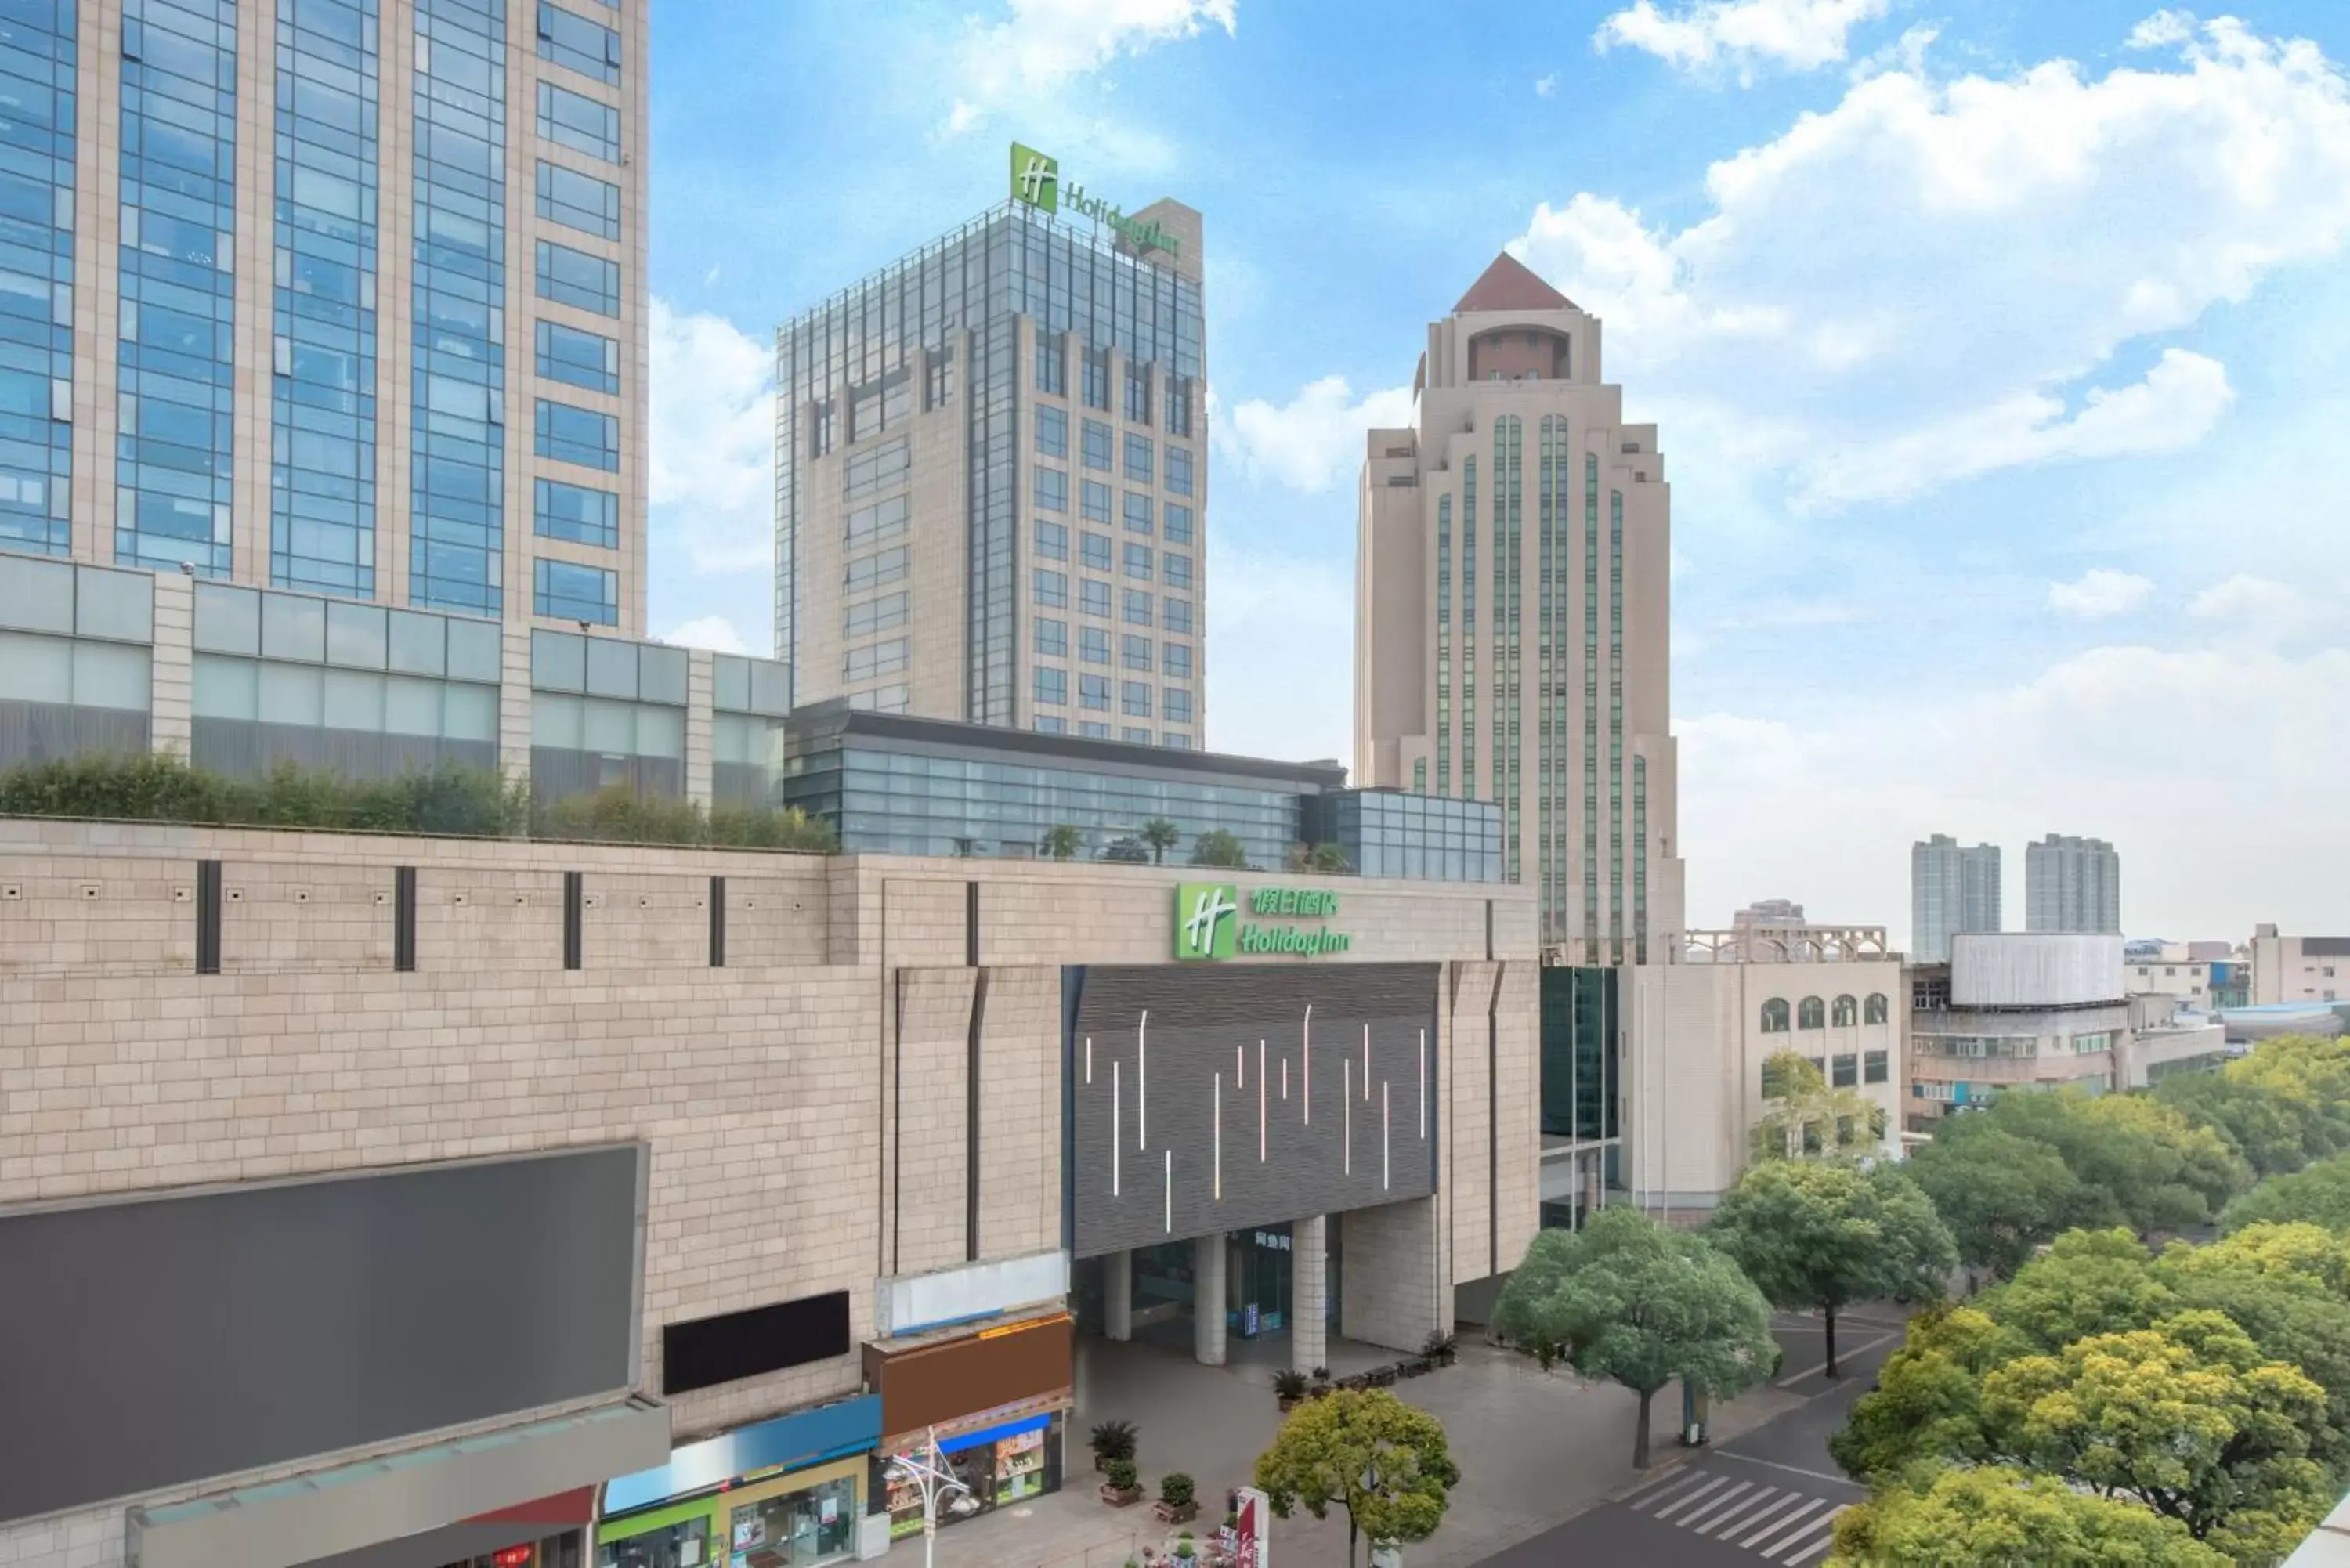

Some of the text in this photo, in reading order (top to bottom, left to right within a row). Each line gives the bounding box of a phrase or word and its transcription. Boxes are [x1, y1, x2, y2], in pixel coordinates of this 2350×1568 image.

[1251, 886, 1340, 916] 假日酒店
[1242, 923, 1321, 958] Holiday
